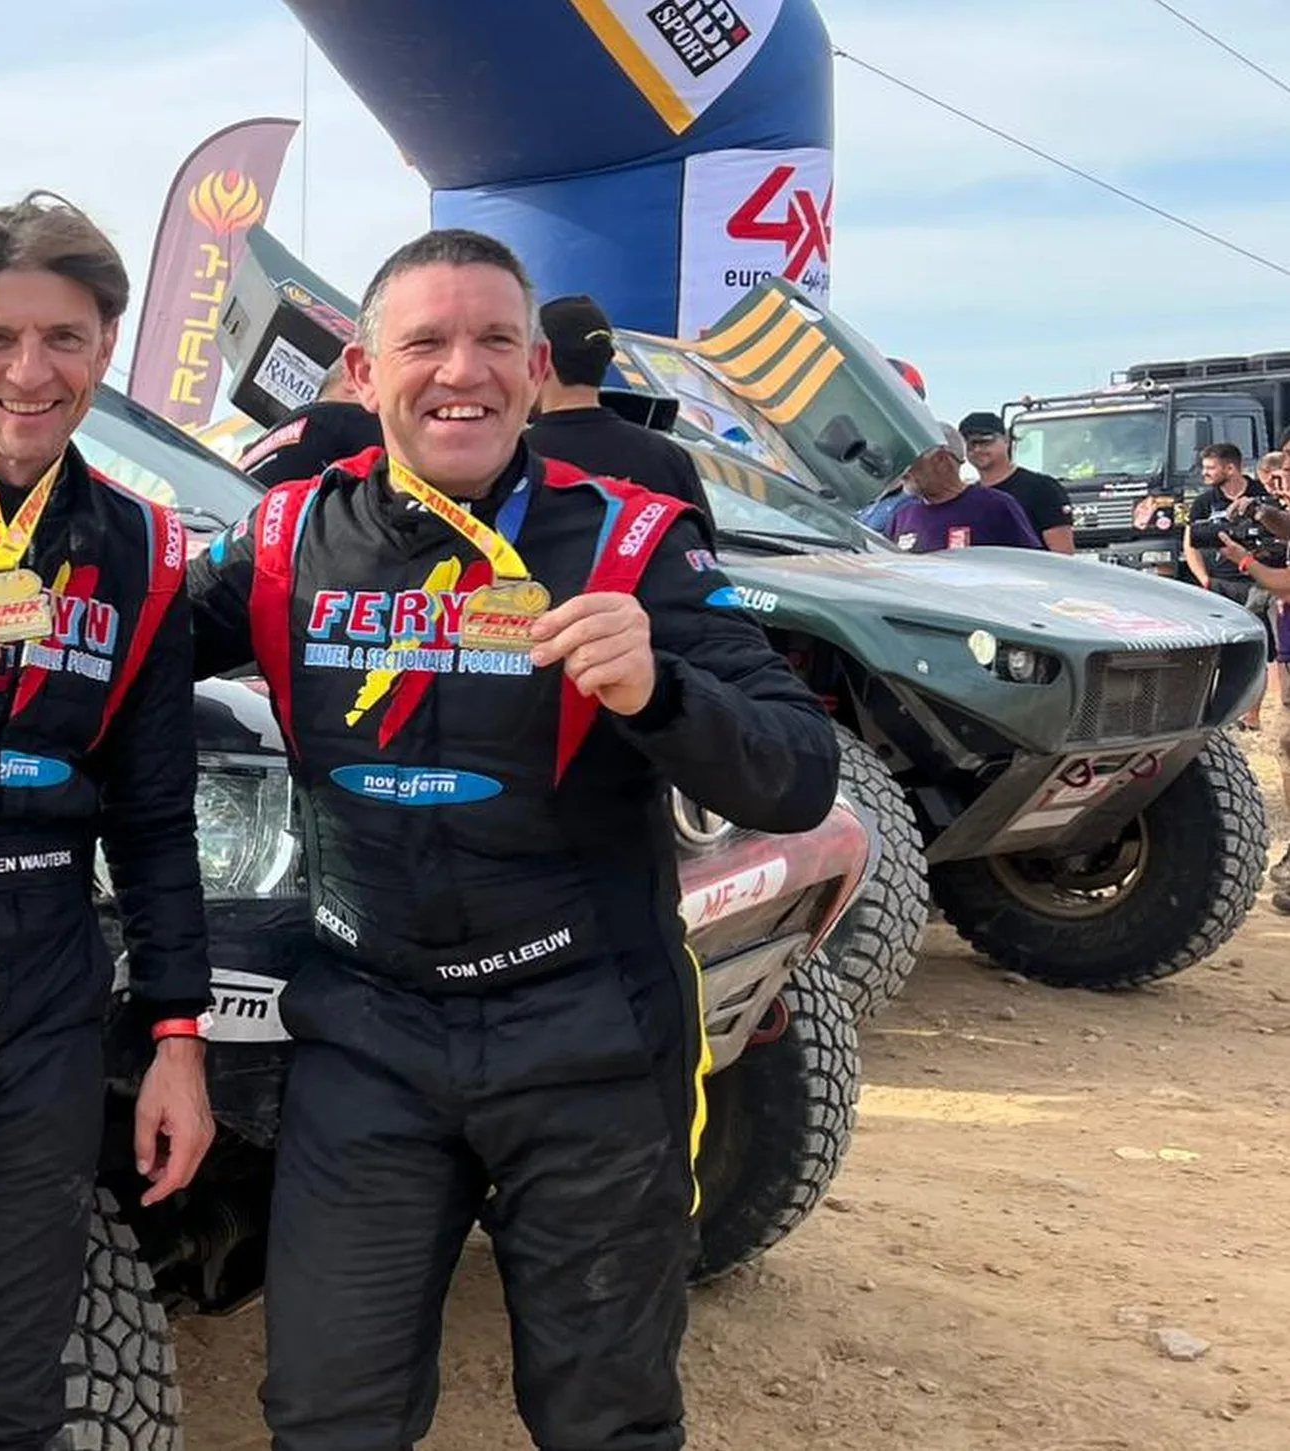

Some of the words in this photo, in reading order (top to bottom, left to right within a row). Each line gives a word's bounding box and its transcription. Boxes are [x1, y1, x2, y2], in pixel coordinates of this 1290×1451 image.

[654, 4, 714, 68] SPORT
[169, 243, 229, 405] RALLY
[618, 502, 669, 558] sparco
[307, 588, 467, 643] FERY
[468, 612, 533, 628] FENI
[733, 586, 779, 612] CLUB
[364, 773, 458, 798] novoferm
[19, 850, 72, 871] WAUTERS
[314, 904, 359, 948] sparco
[436, 963, 479, 980] TOM
[479, 953, 508, 975] DE
[509, 928, 573, 966] LEEUW
